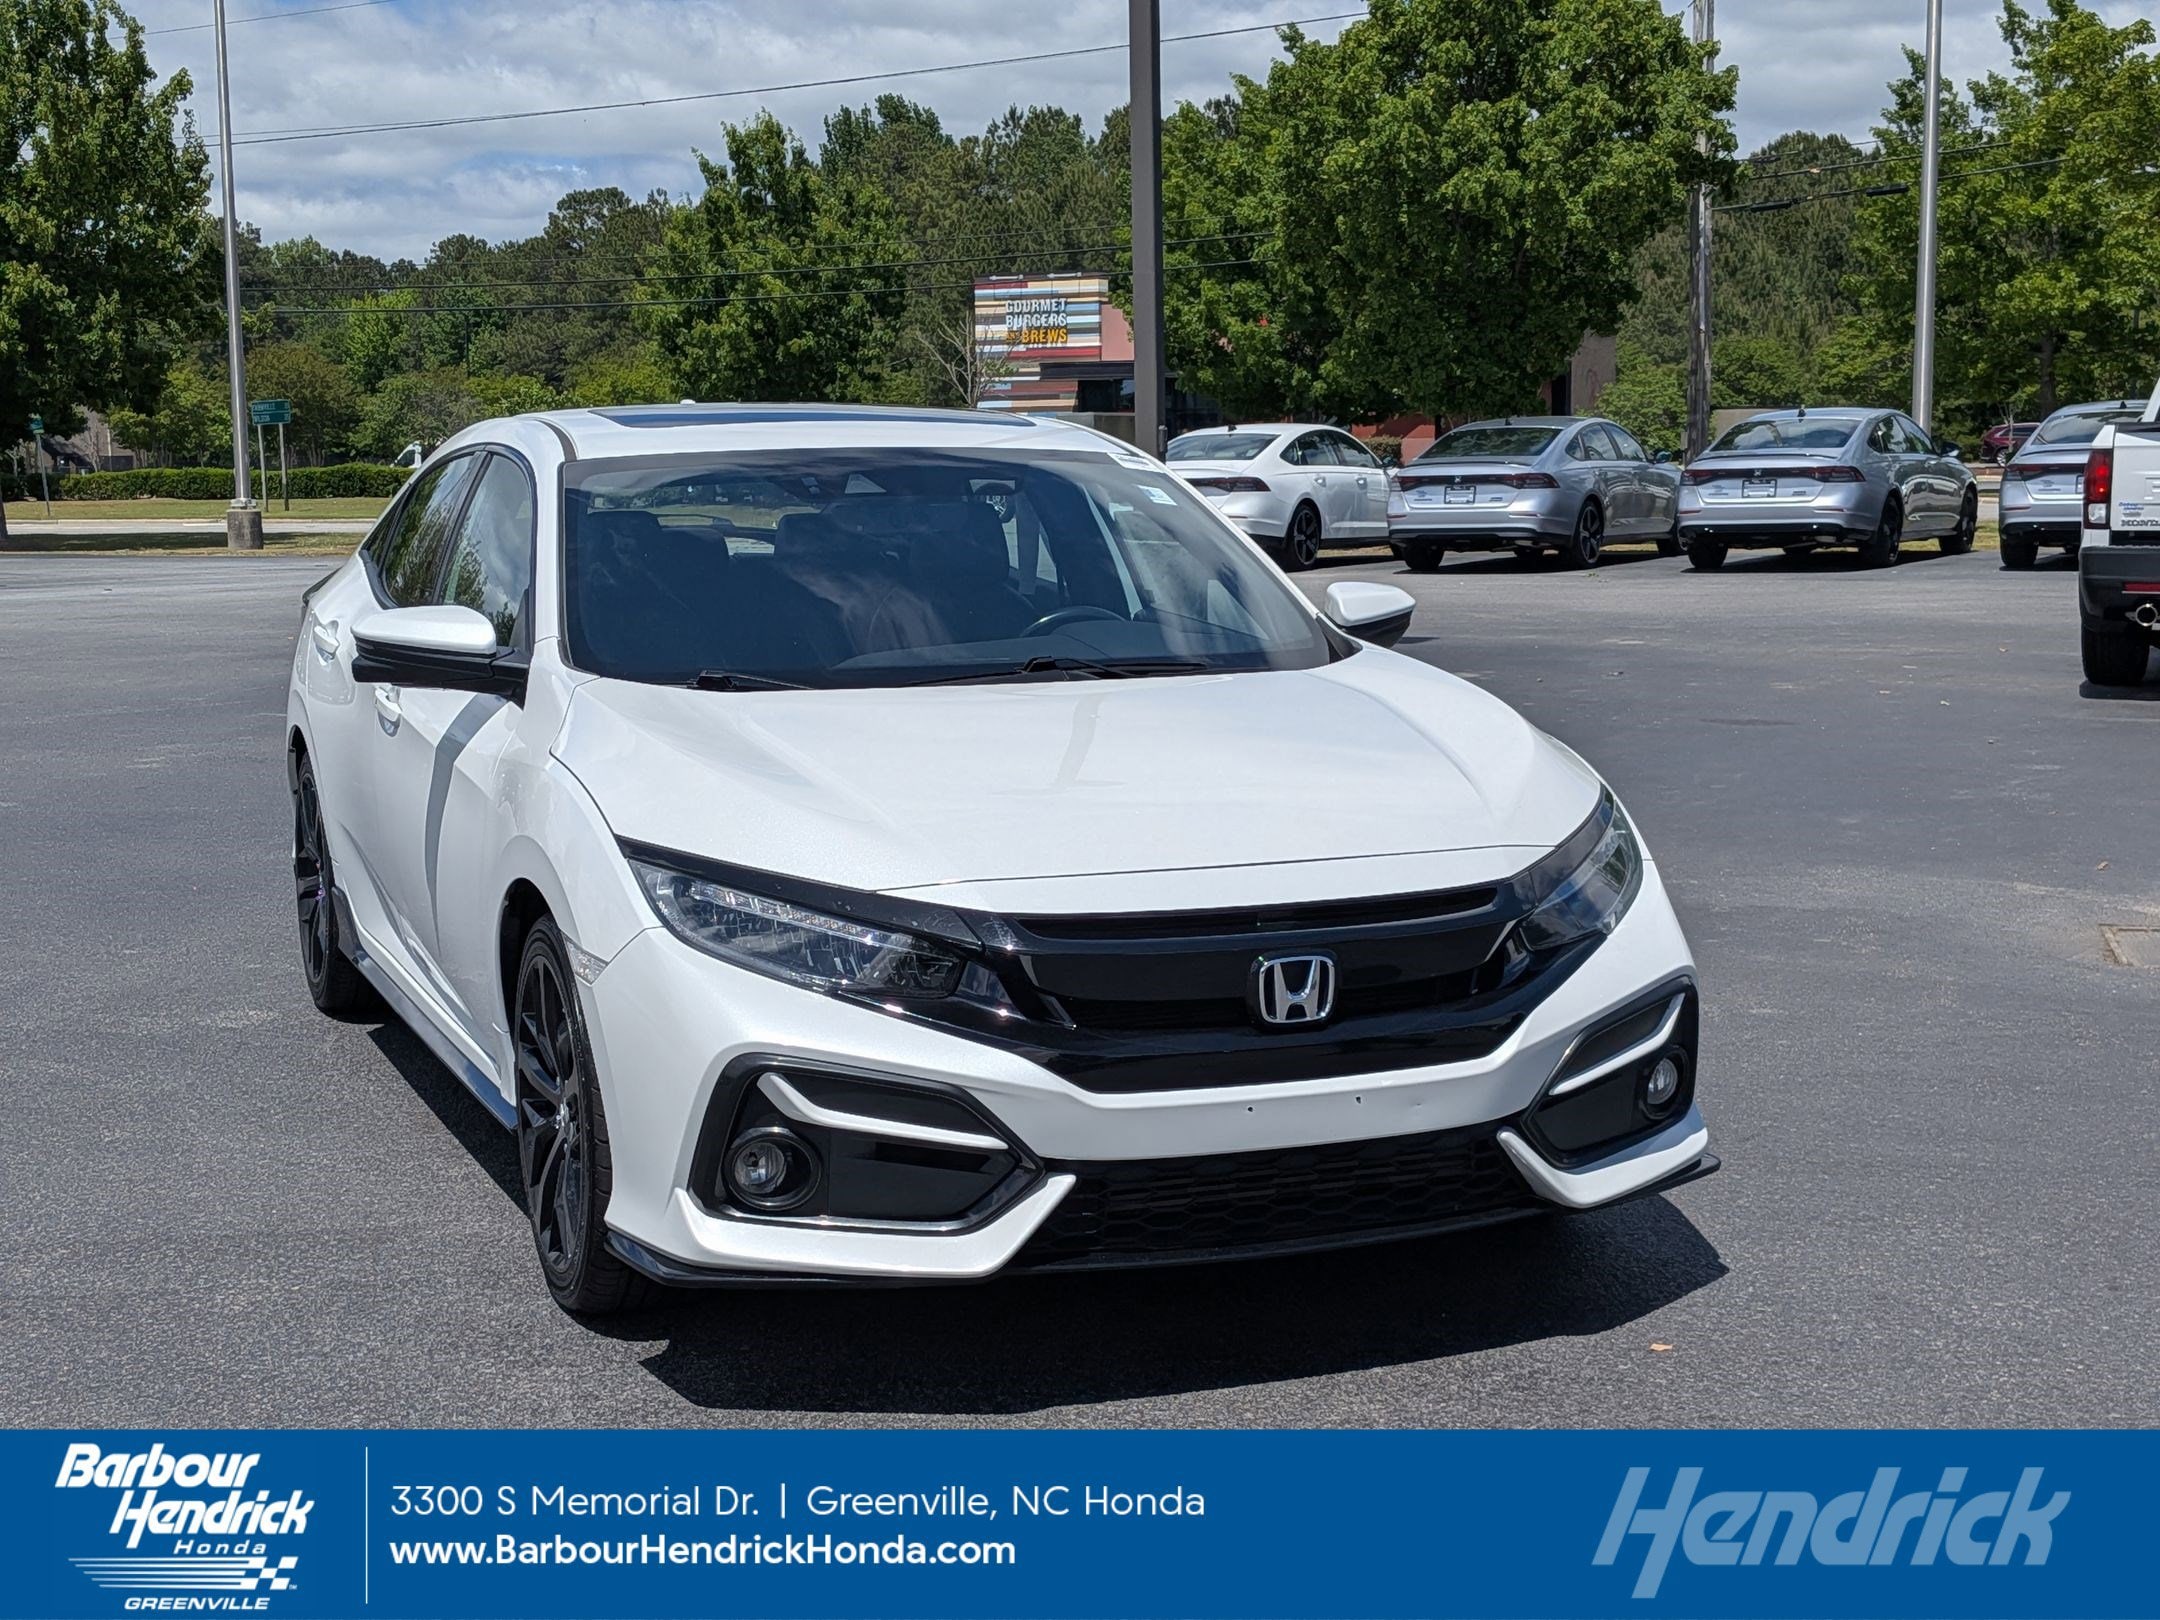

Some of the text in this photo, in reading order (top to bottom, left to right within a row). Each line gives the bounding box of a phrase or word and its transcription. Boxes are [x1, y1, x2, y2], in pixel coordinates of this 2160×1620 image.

[1006, 298, 1067, 313] GOURMET
[1006, 313, 1067, 329] BURGERS
[1021, 328, 1067, 343] BREWS
